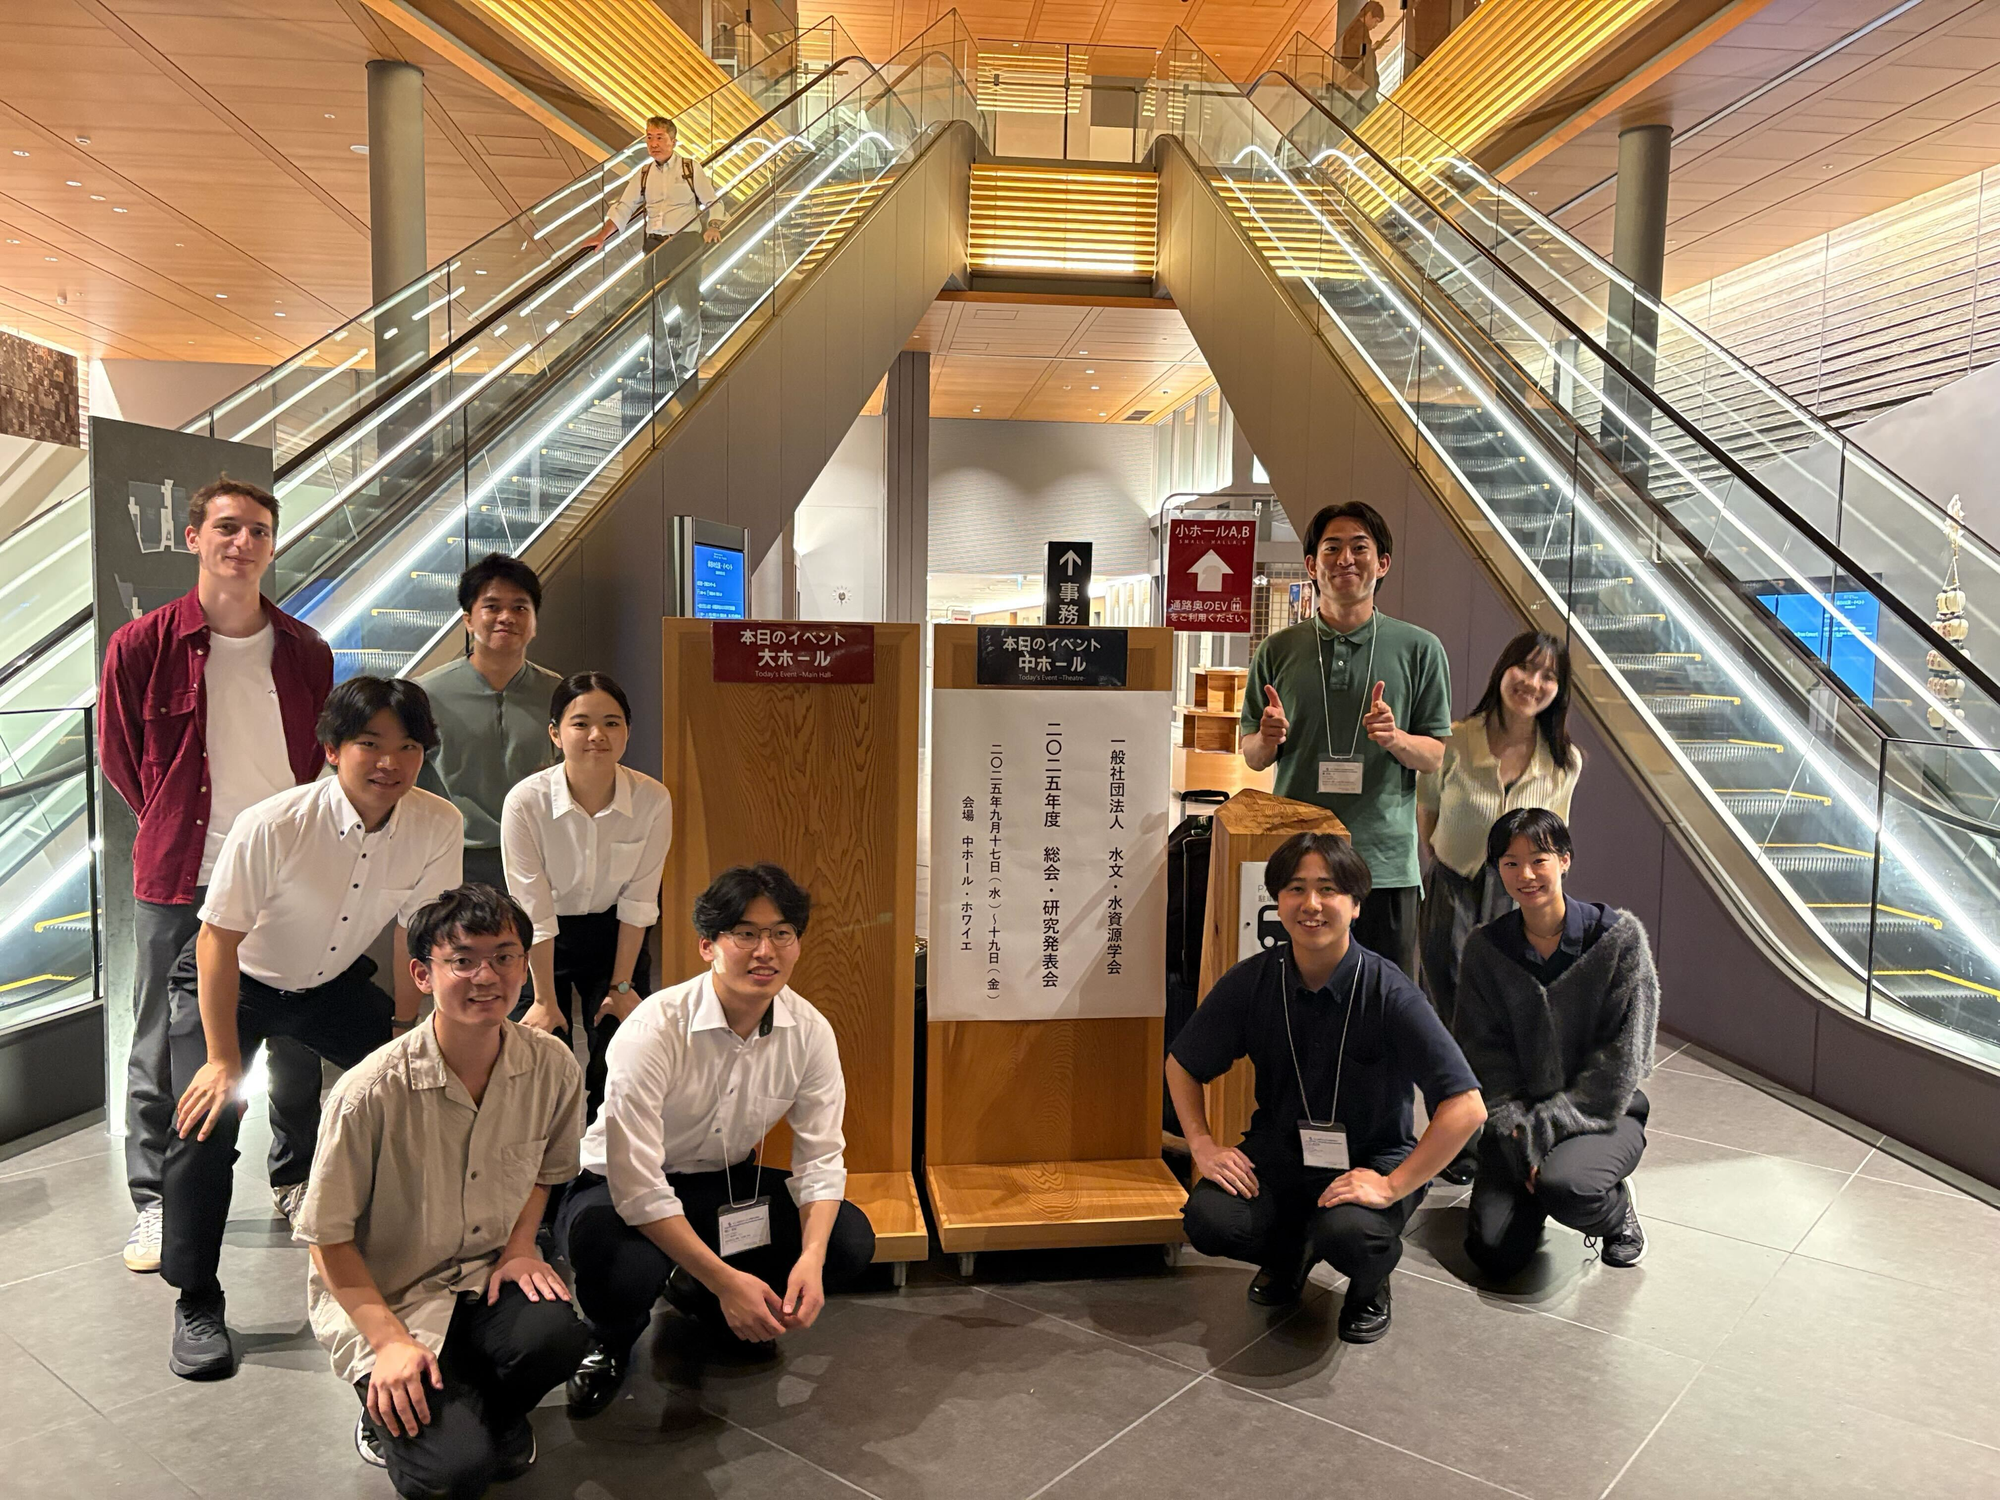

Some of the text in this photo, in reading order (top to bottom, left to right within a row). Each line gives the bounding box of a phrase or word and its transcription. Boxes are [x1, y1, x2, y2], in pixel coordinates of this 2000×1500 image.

[1175, 524, 1250, 539] 小ホールA,B
[1058, 582, 1080, 625] 事務
[1170, 600, 1229, 611] 通路奥のEV
[1170, 613, 1248, 624] をご利用ください。
[740, 628, 846, 646] 本日のイベント
[1002, 636, 1101, 652] 本日のイベント
[757, 648, 831, 667] 大ホール
[1018, 656, 1087, 673] 中ホール
[755, 670, 779, 678] Today's
[1042, 723, 1062, 988] 二〇二五年度 総会・研究発表会
[1106, 739, 1126, 975] 一般社団法人 水文・水資源学会
[960, 796, 975, 951] 会場 中ホール・ホワイエ
